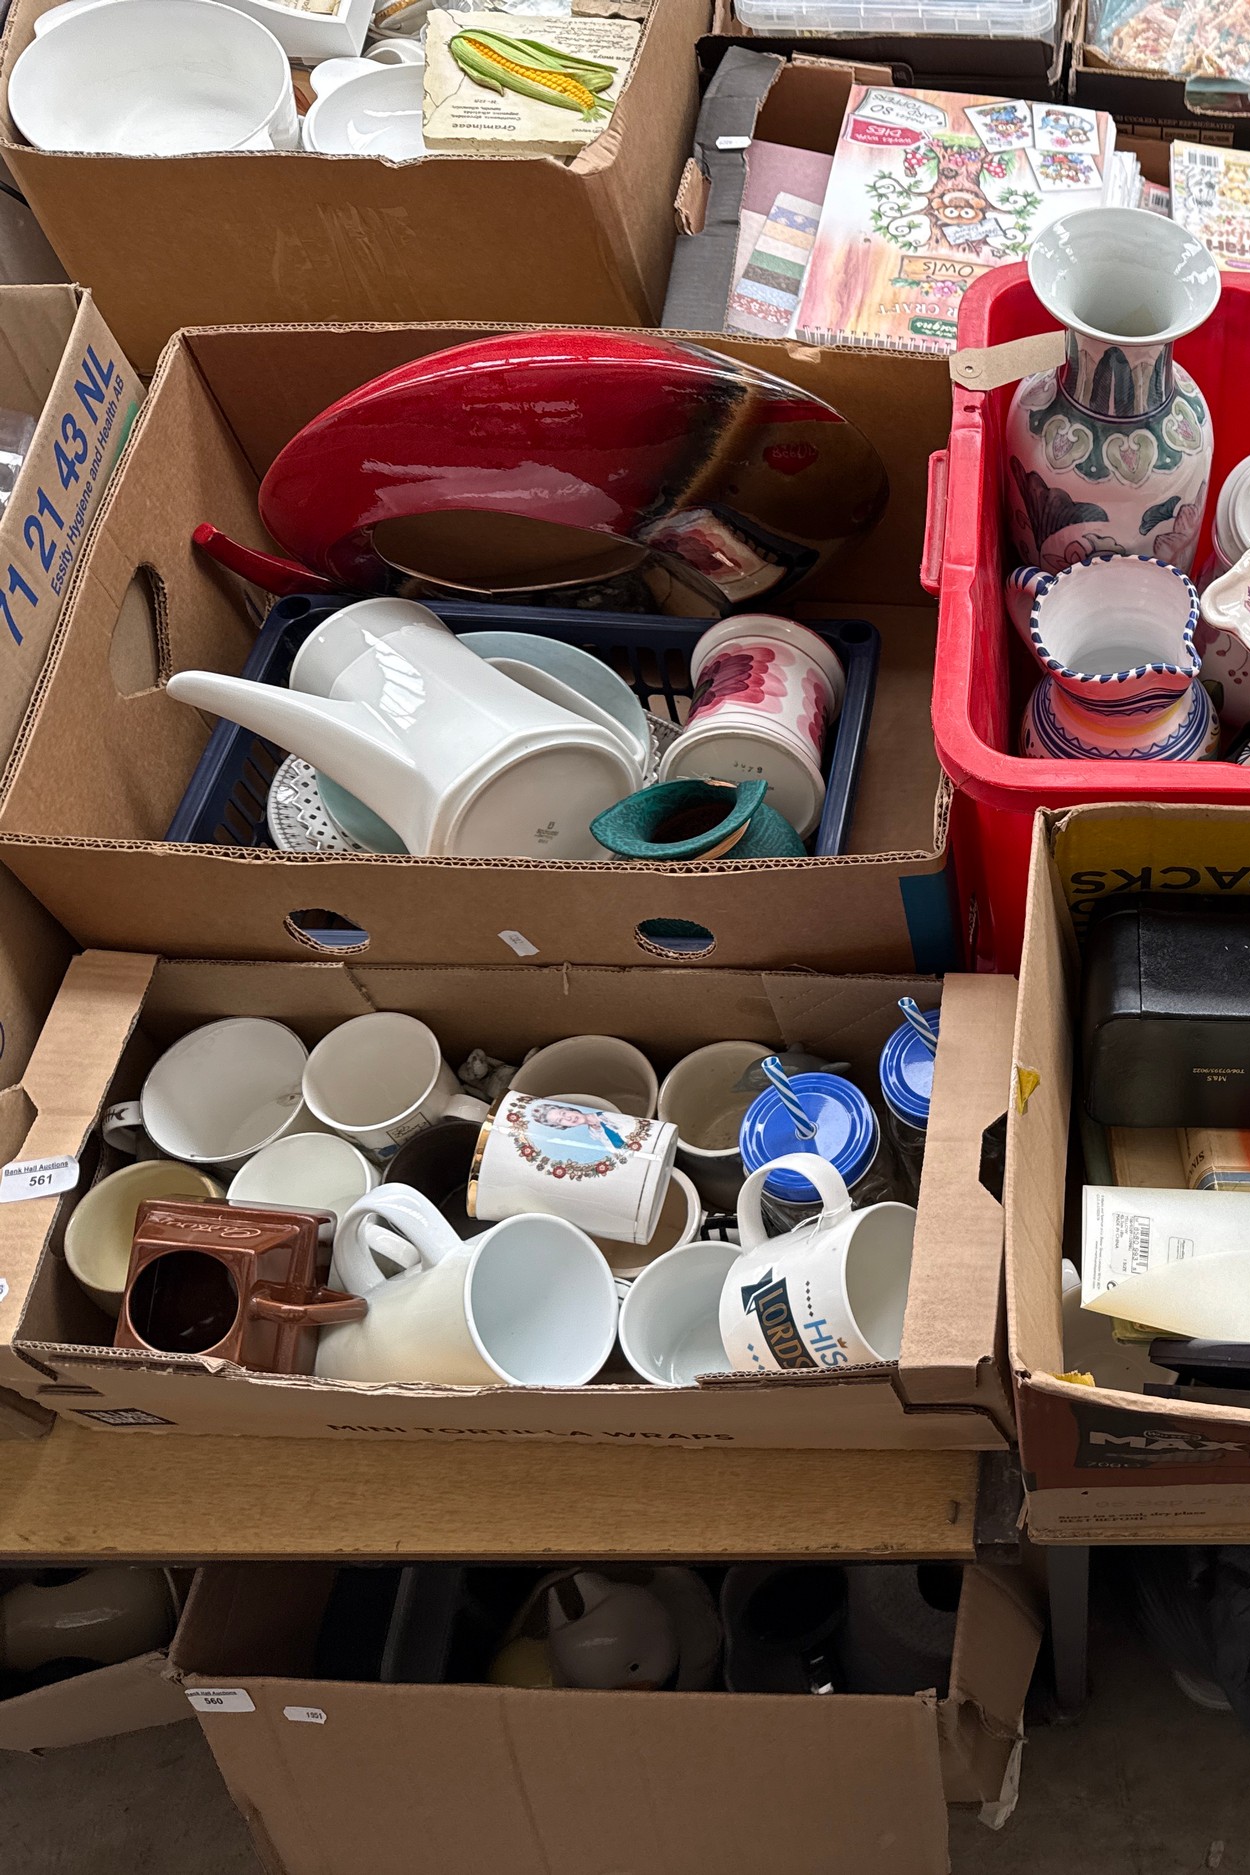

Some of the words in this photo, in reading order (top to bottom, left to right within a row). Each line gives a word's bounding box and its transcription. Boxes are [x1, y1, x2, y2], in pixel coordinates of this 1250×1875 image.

[871, 93, 922, 111] TOPPERS
[907, 109, 940, 123] CARD
[452, 122, 516, 132] Gramineae
[866, 125, 902, 138] DIES
[882, 136, 912, 145] works
[922, 260, 974, 279] Owls
[876, 302, 940, 318] CRAFT
[113, 374, 125, 399] AB
[96, 400, 119, 451] Health
[24, 486, 65, 574] 21
[53, 412, 88, 491] 43
[73, 344, 115, 425] NL
[89, 447, 104, 482] and
[66, 478, 94, 543] Hygiene
[50, 545, 75, 598] Essity
[1205, 1075, 1228, 1083] M&S
[4, 1168, 23, 1177] Bank
[24, 1165, 38, 1174] Hall
[38, 1160, 69, 1172] Auctions
[29, 1174, 53, 1187] 561
[758, 1287, 814, 1369] LORDS
[803, 1318, 848, 1367] HIS
[326, 1423, 407, 1434] MINI
[601, 1431, 736, 1441] WRAPS
[1089, 1431, 1248, 1452] MAX
[204, 1697, 224, 1705] 560
